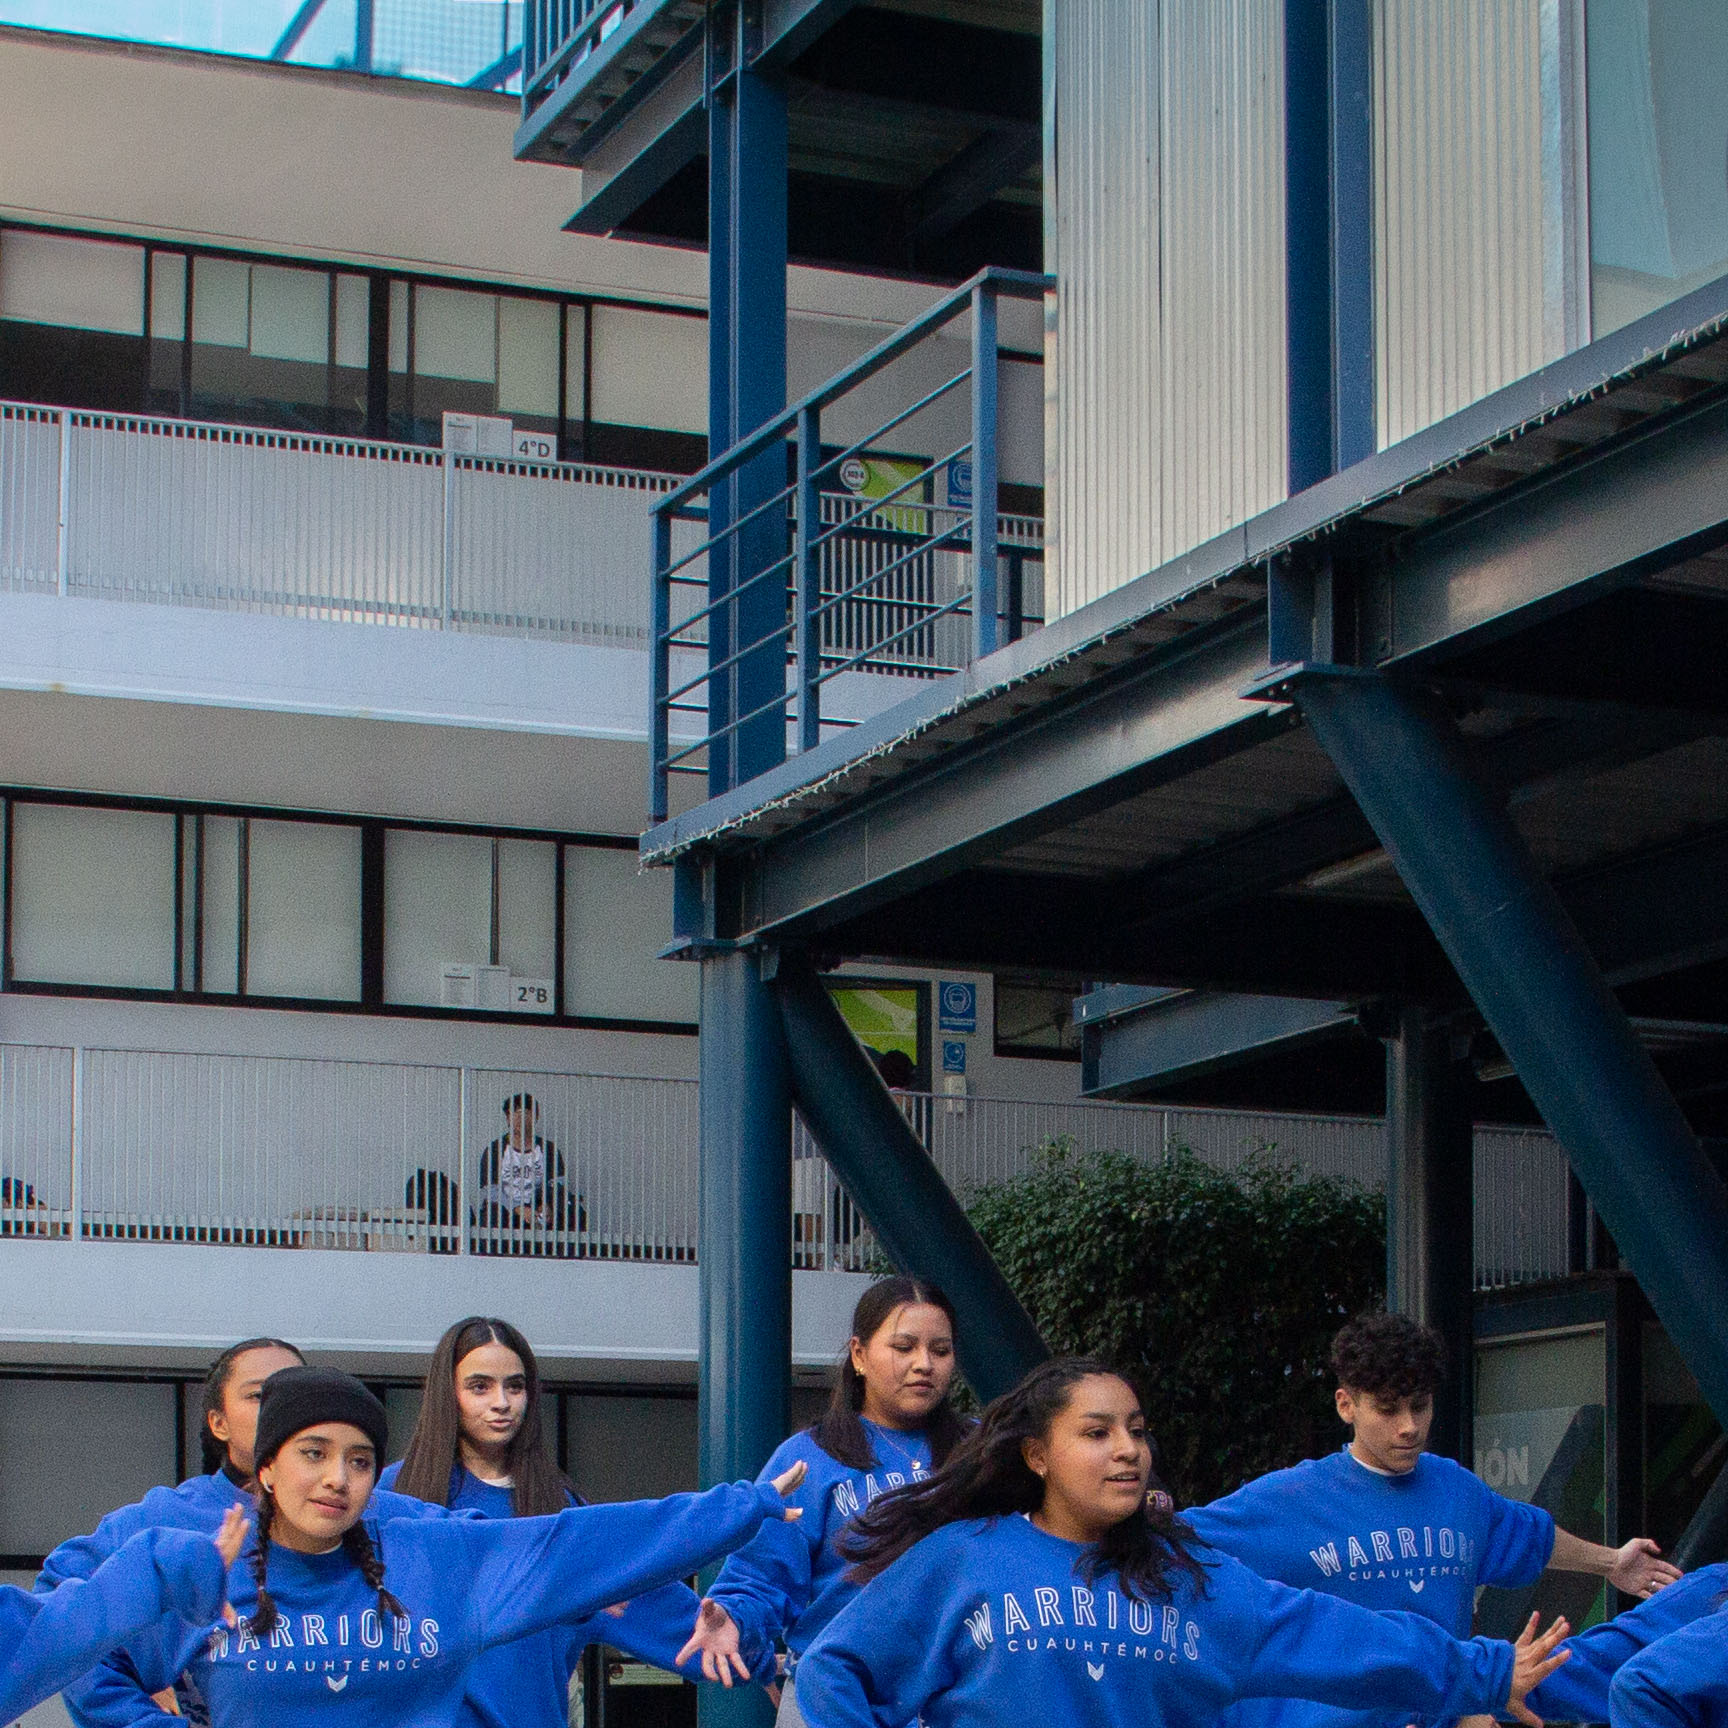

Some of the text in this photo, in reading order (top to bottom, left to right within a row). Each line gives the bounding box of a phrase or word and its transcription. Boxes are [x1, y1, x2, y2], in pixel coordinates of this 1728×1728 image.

[519, 440, 551, 458] 4°D
[516, 986, 548, 1004] 2°B
[1474, 1439, 1530, 1487] IÓN
[209, 1608, 440, 1663] WARRIORS
[964, 1585, 1201, 1662] WARRIORS
[247, 1657, 422, 1673] CUAUHTÉMOC
[1007, 1640, 1179, 1665] CUAUHTÉMOC
